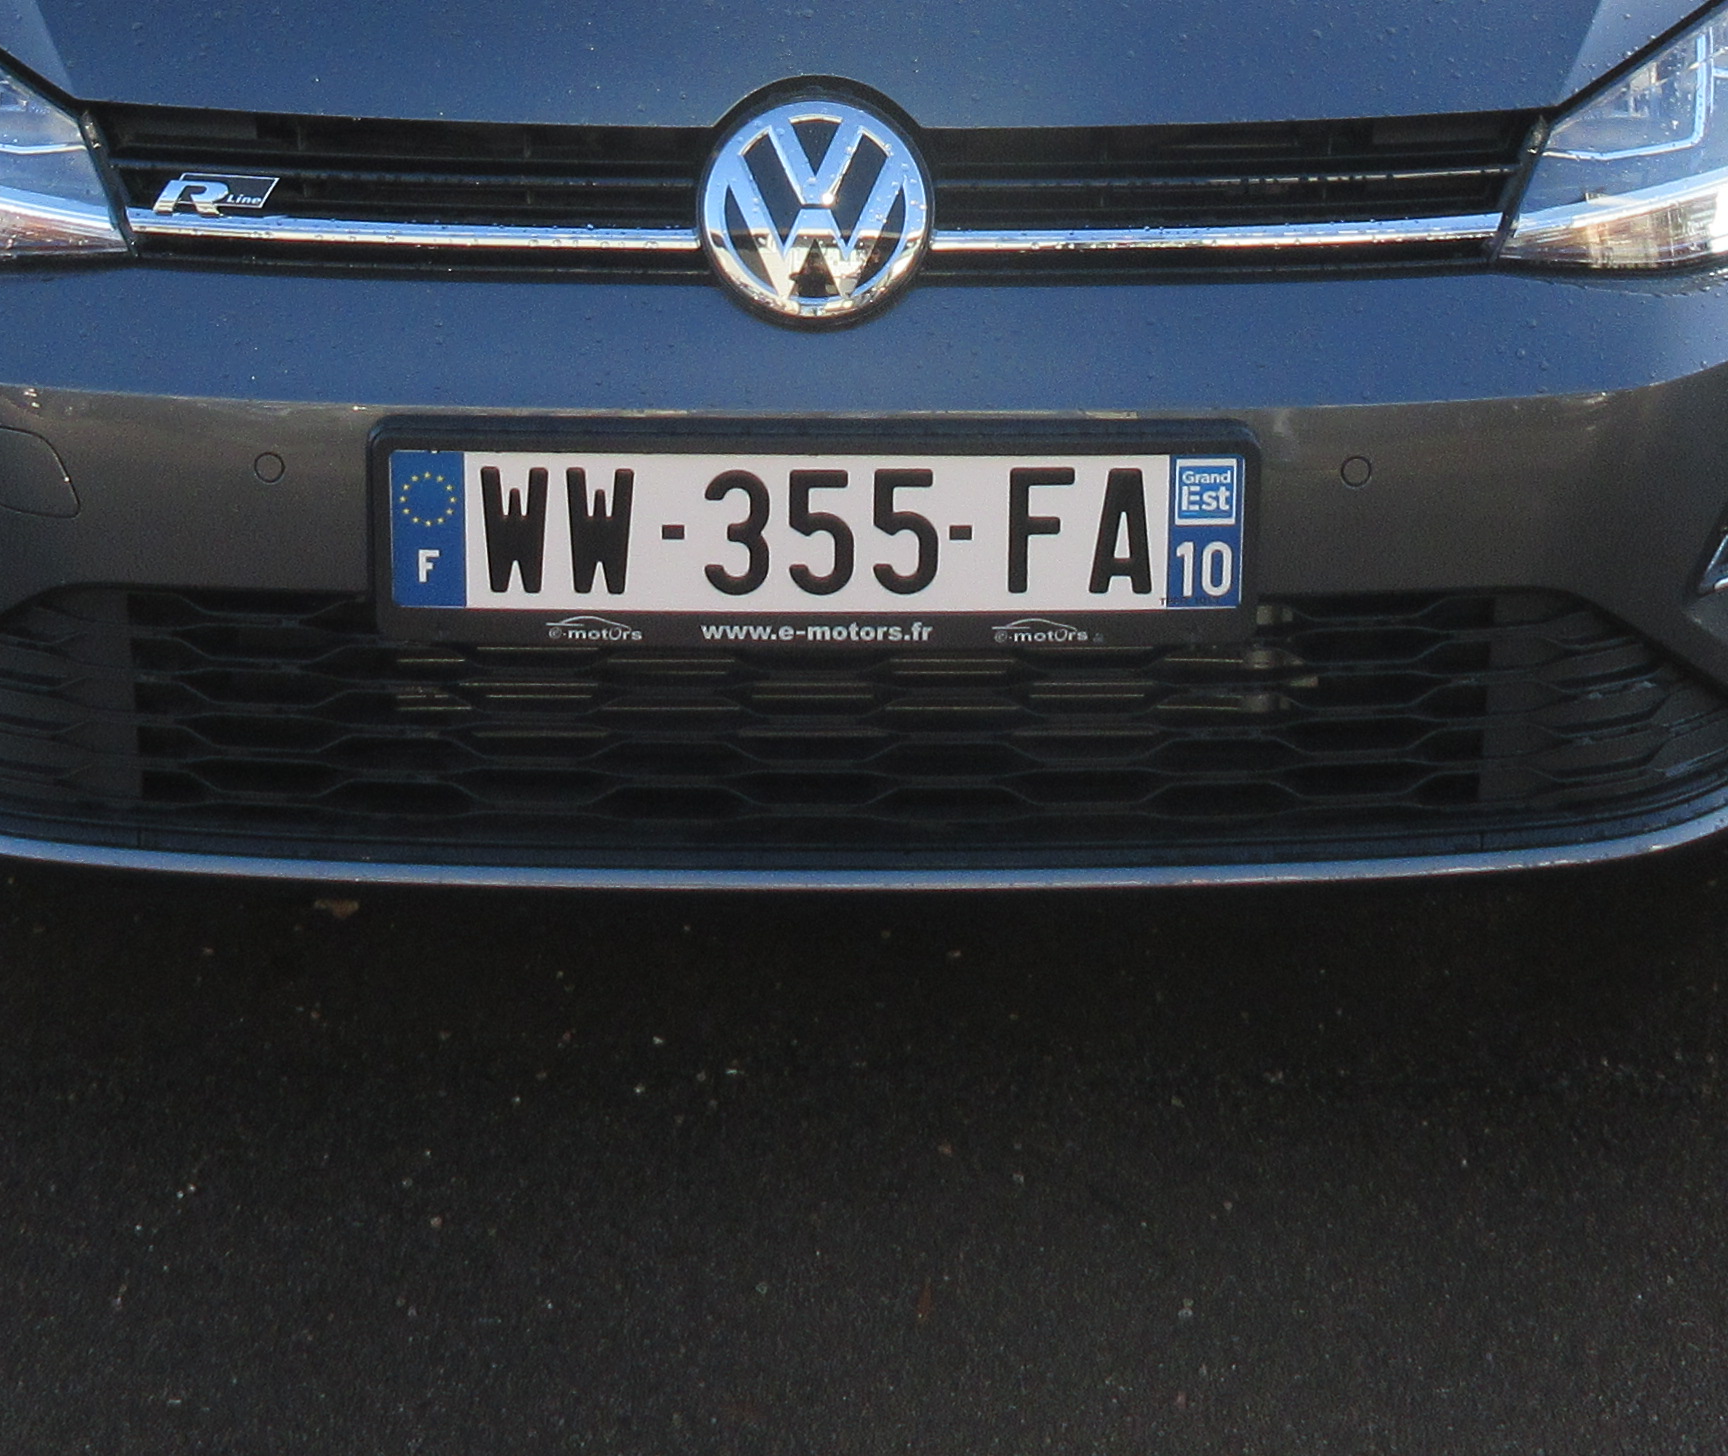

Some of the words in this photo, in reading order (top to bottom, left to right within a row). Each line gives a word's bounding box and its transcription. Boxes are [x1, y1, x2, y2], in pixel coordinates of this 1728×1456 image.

[152, 180, 229, 219] R
[226, 194, 262, 205] Line
[1182, 470, 1232, 485] Grand
[1181, 485, 1231, 512] Est
[479, 466, 1153, 596] WW-355-FA
[416, 548, 440, 584] F
[1176, 541, 1233, 597] 10
[700, 622, 933, 643] www.e-motors.fr
